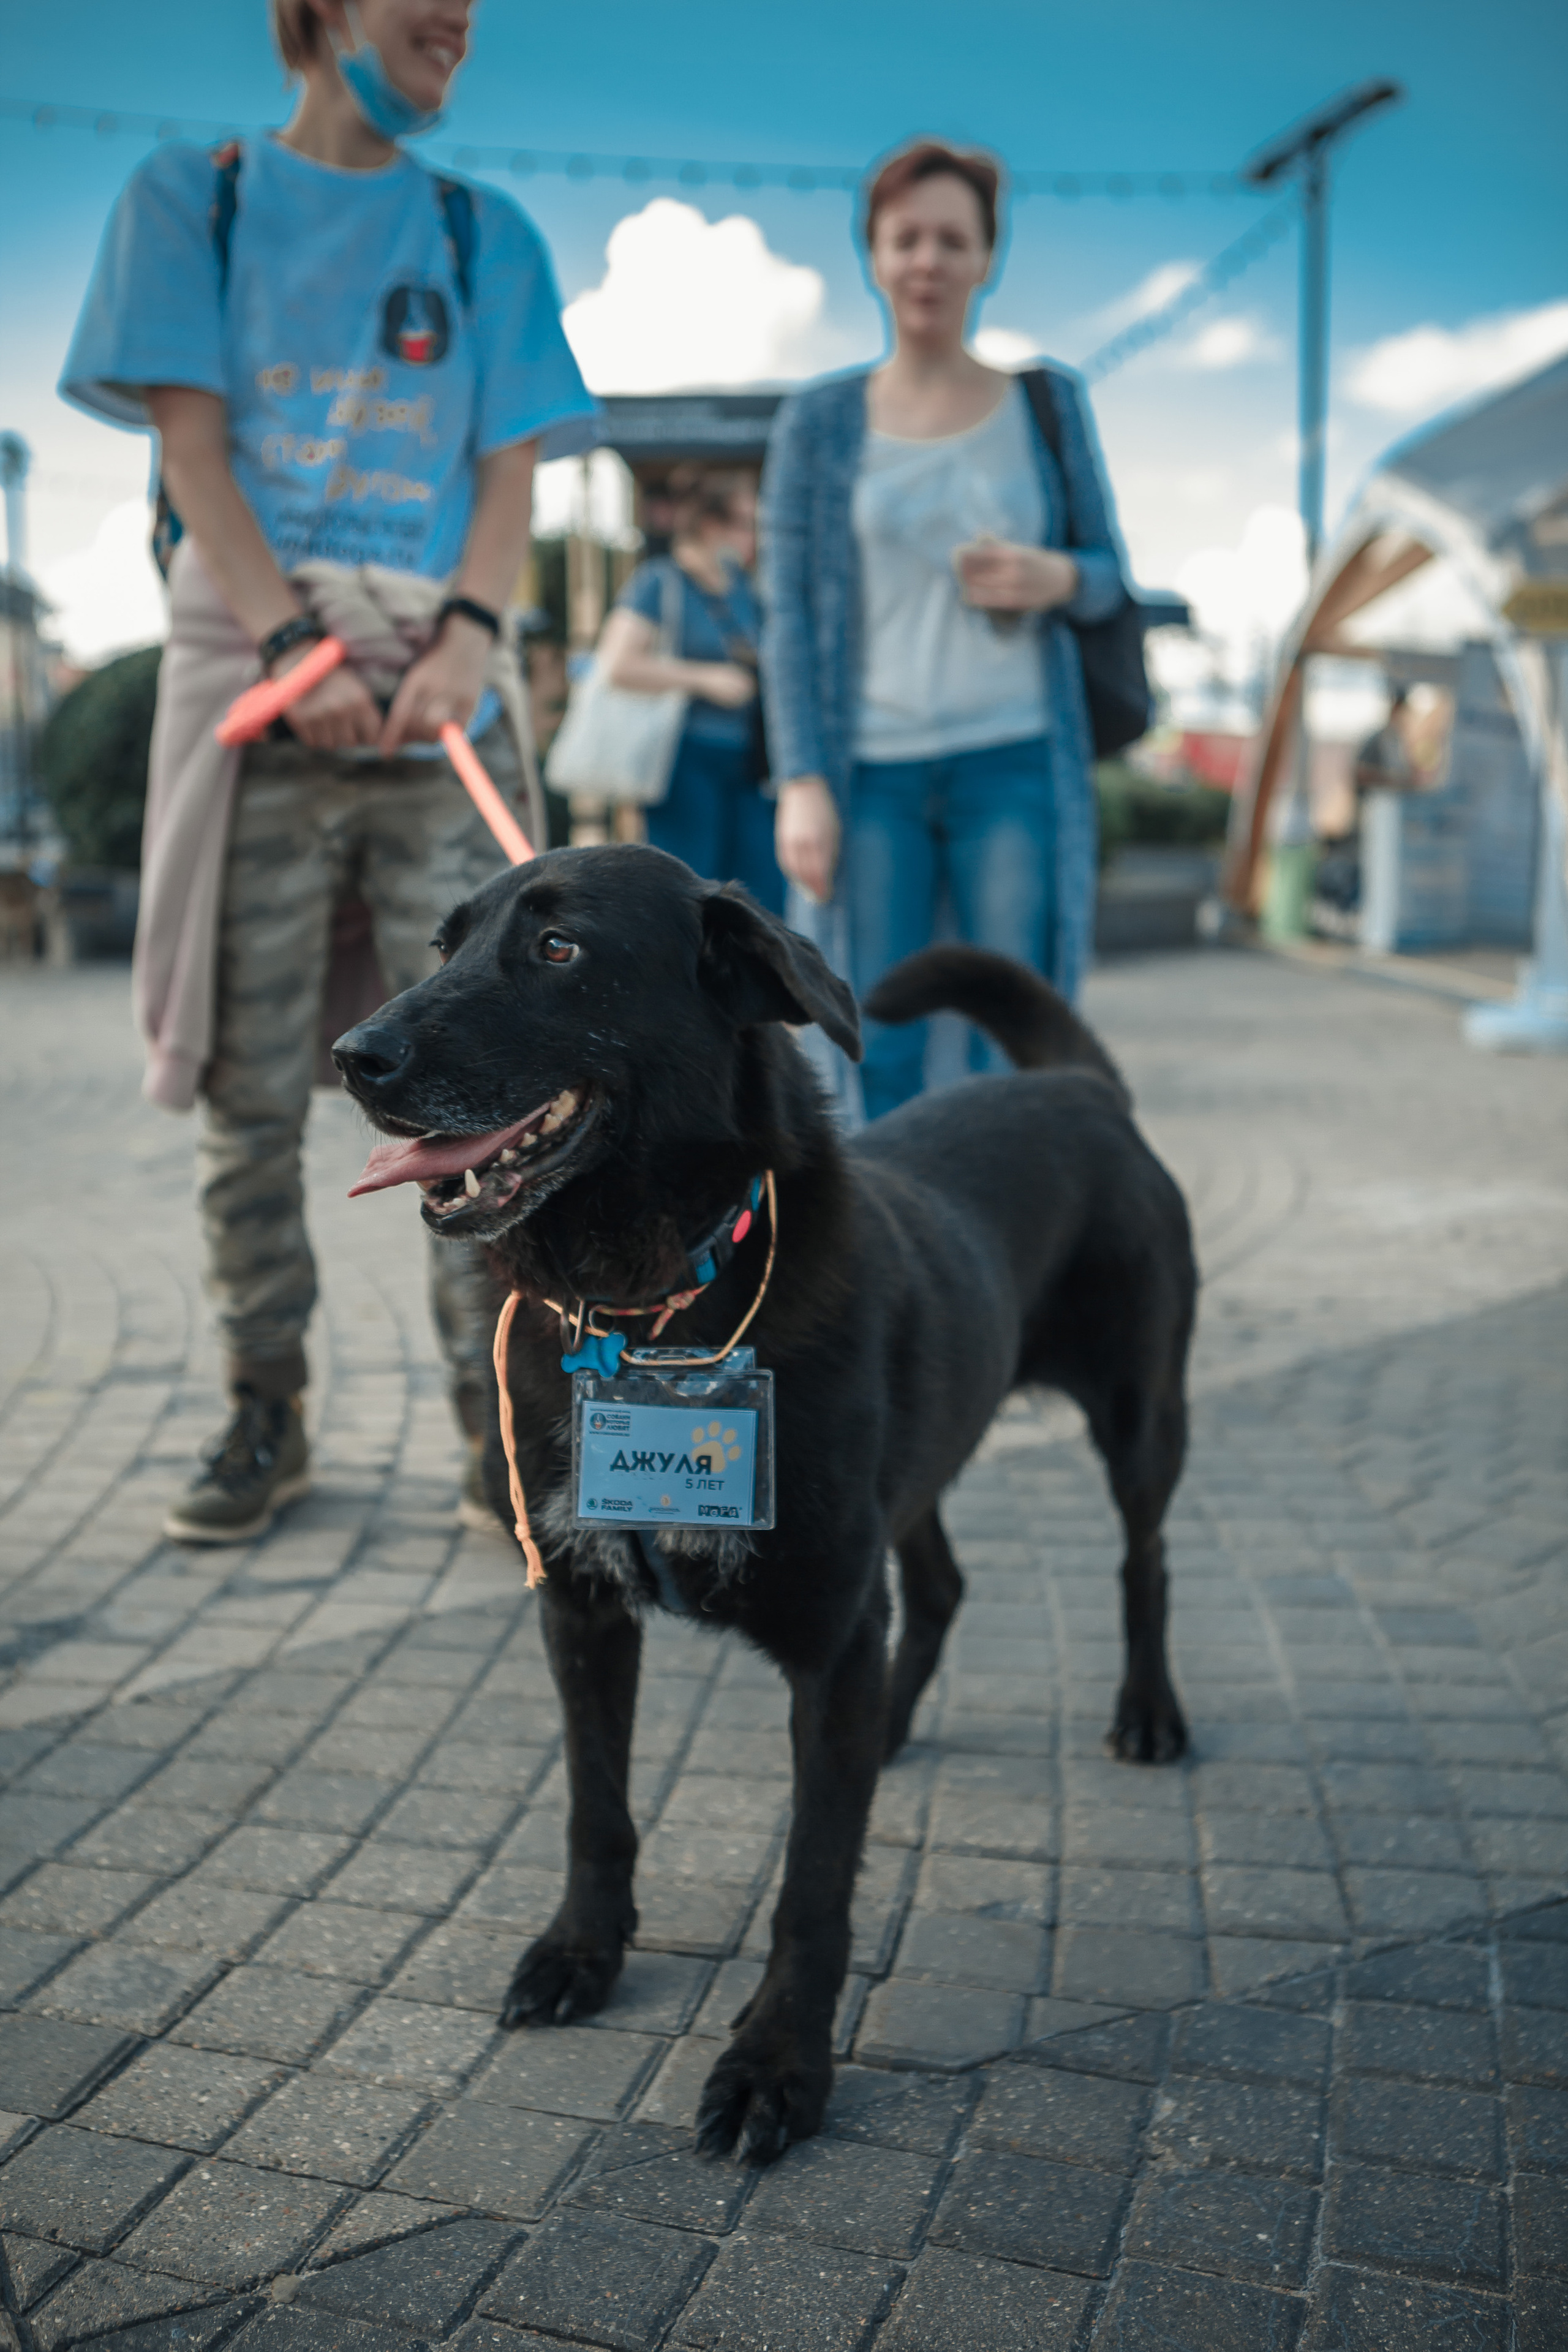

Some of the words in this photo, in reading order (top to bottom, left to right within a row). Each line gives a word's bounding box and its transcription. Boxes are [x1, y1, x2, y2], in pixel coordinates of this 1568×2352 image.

[609, 1450, 712, 1476] ДЖУЛЯ
[685, 1479, 693, 1489] 5
[696, 1479, 725, 1490] ЛЕТ
